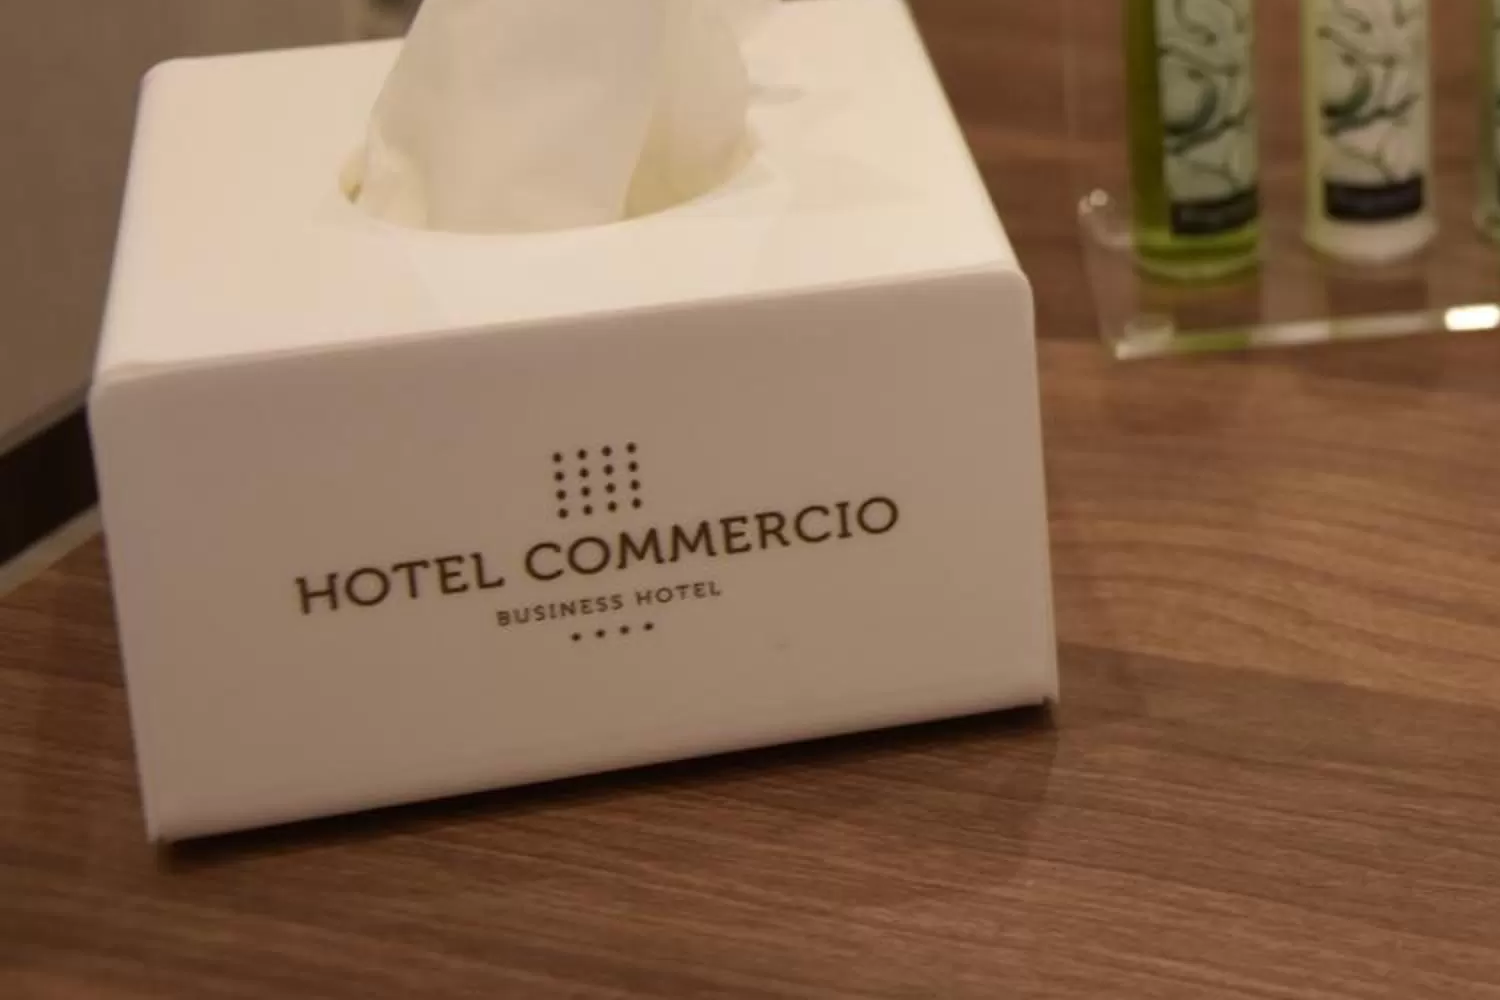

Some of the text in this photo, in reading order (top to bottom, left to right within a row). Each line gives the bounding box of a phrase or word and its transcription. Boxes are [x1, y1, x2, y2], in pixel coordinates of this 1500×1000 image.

[295, 496, 900, 615] HOTEL COMMERCIO
[496, 581, 722, 627] BUSINESS HOTEL
